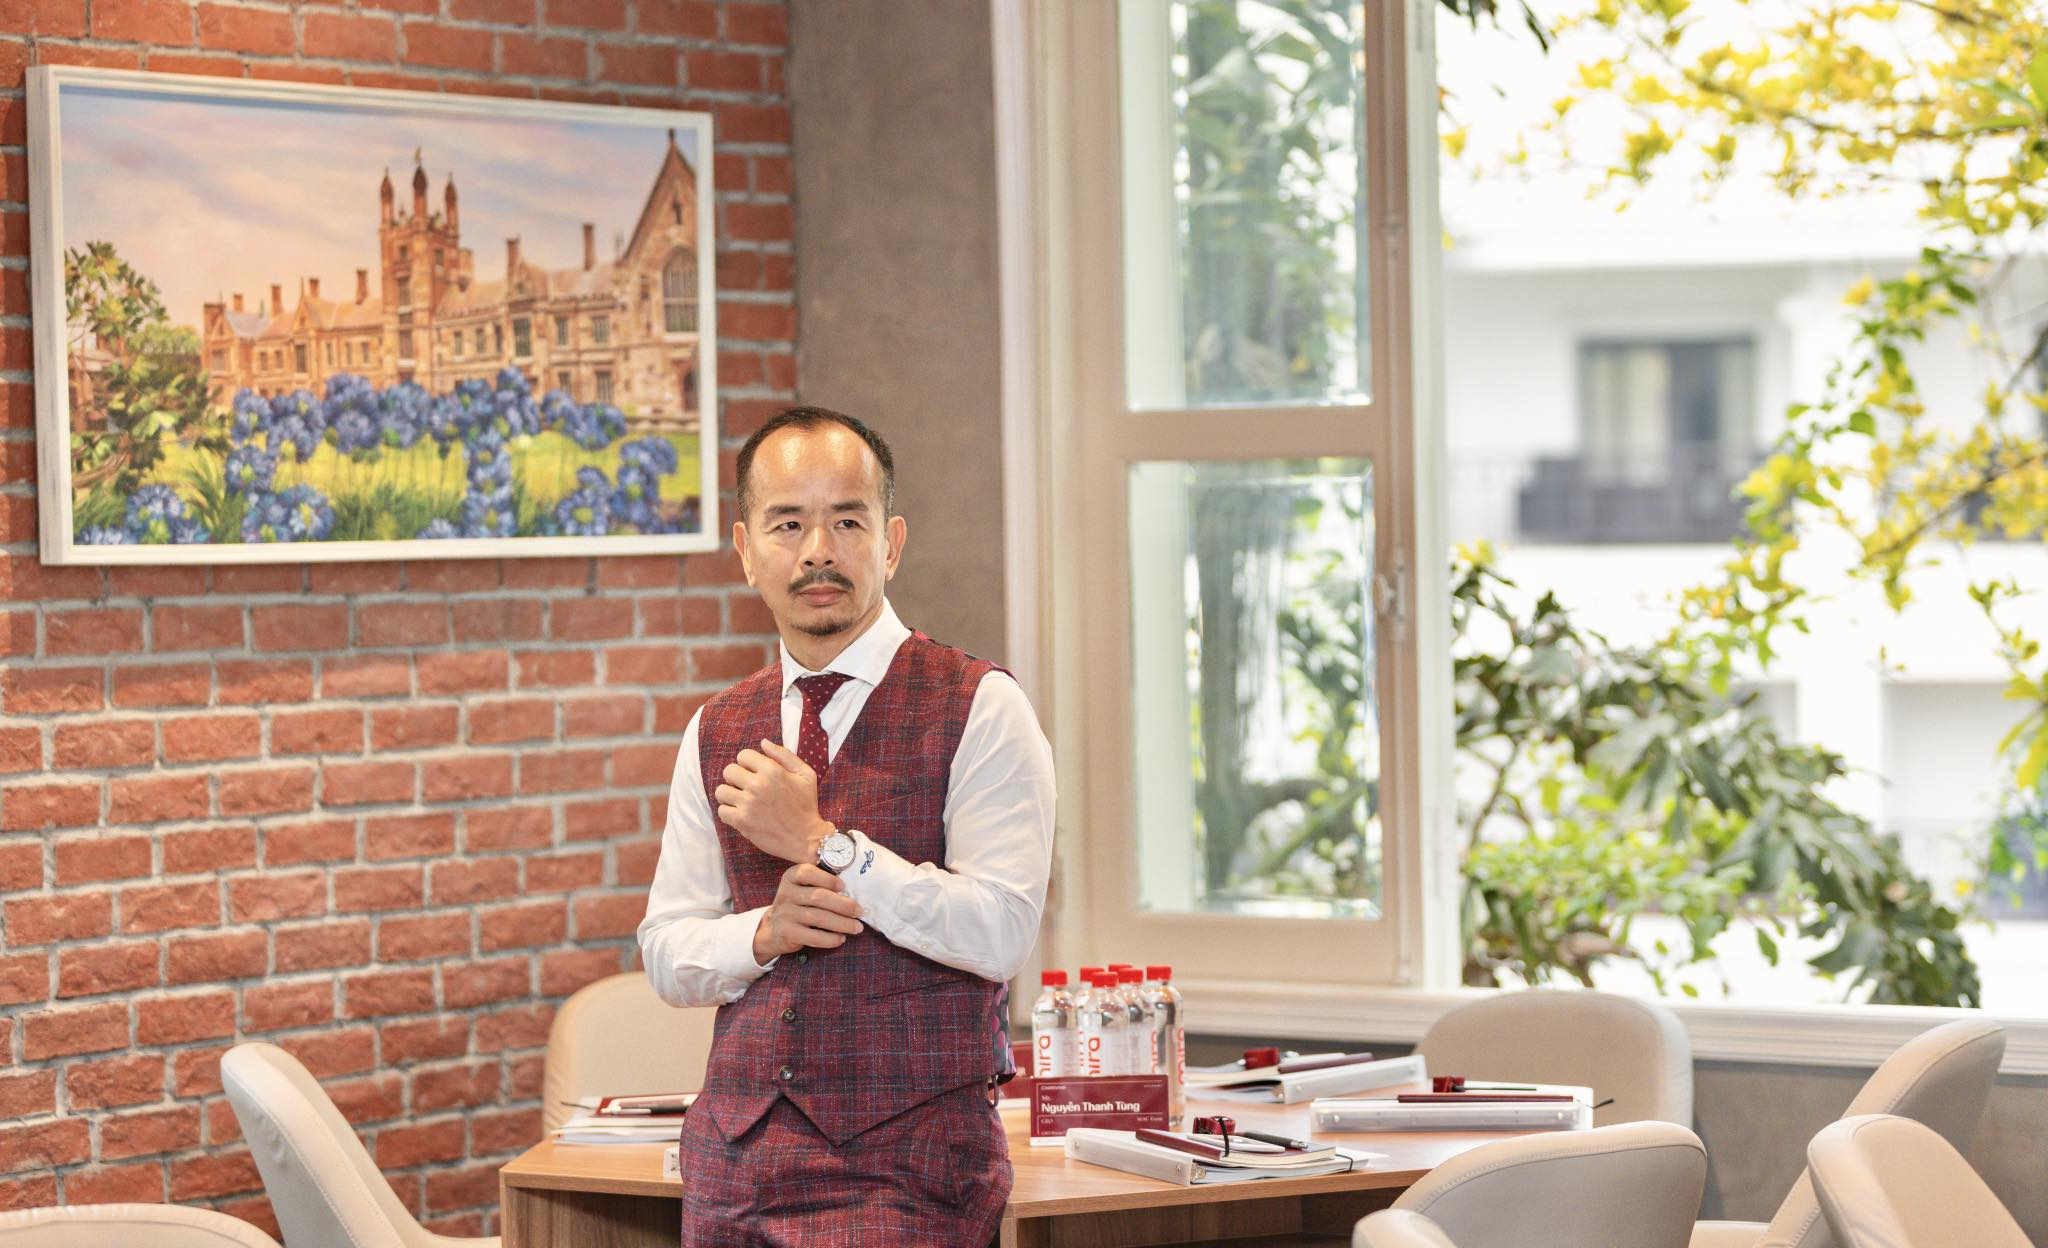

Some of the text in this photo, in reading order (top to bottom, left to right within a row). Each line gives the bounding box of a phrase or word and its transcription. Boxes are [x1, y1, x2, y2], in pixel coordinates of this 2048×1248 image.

[1041, 1101, 1140, 1114] Nguyễn Thanh Tùng
